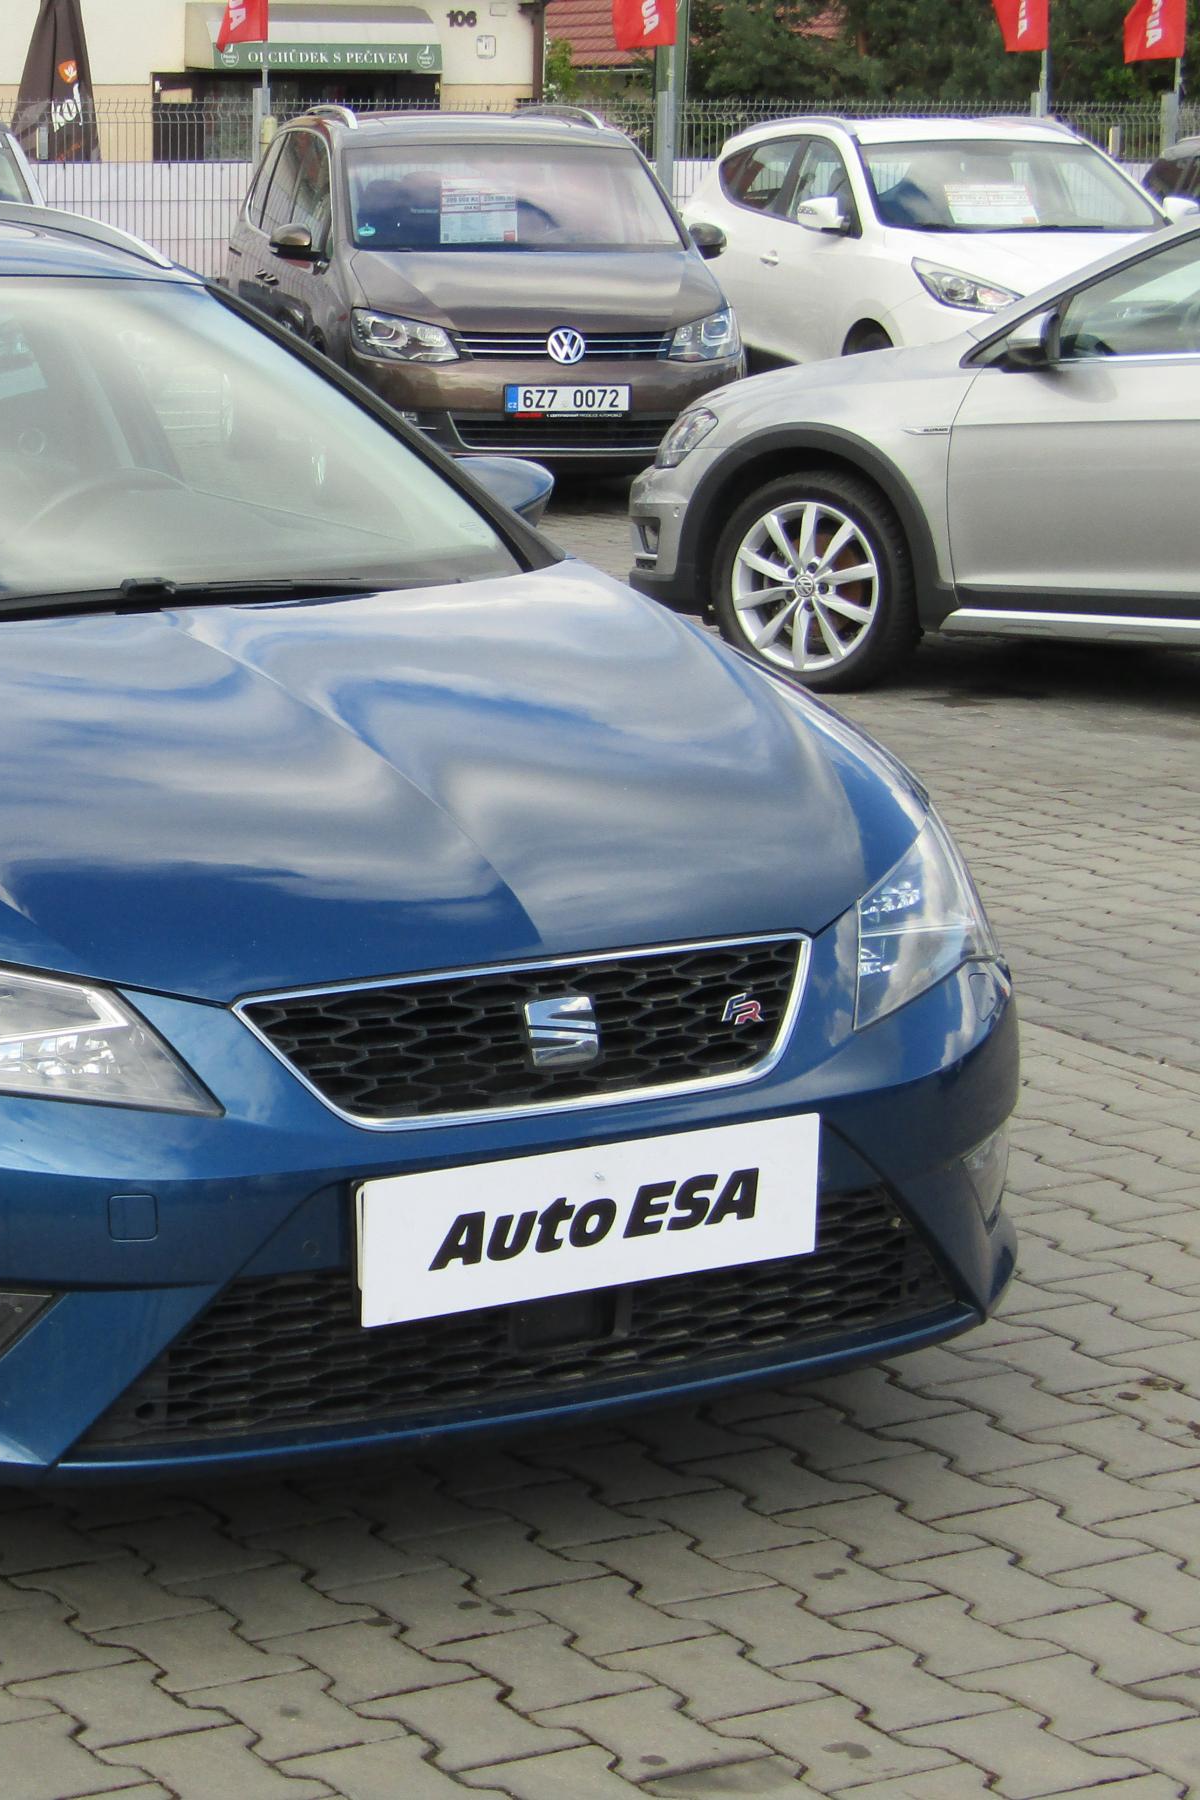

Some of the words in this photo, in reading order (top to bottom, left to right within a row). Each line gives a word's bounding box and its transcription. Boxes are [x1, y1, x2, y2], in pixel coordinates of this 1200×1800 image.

[333, 52, 342, 63] S
[346, 49, 409, 64] PEČIVEM
[522, 389, 558, 409] 6Z7
[573, 389, 620, 409] 0072
[720, 991, 765, 1025] FR
[427, 1196, 618, 1272] Auto
[622, 1166, 760, 1240] ESA
